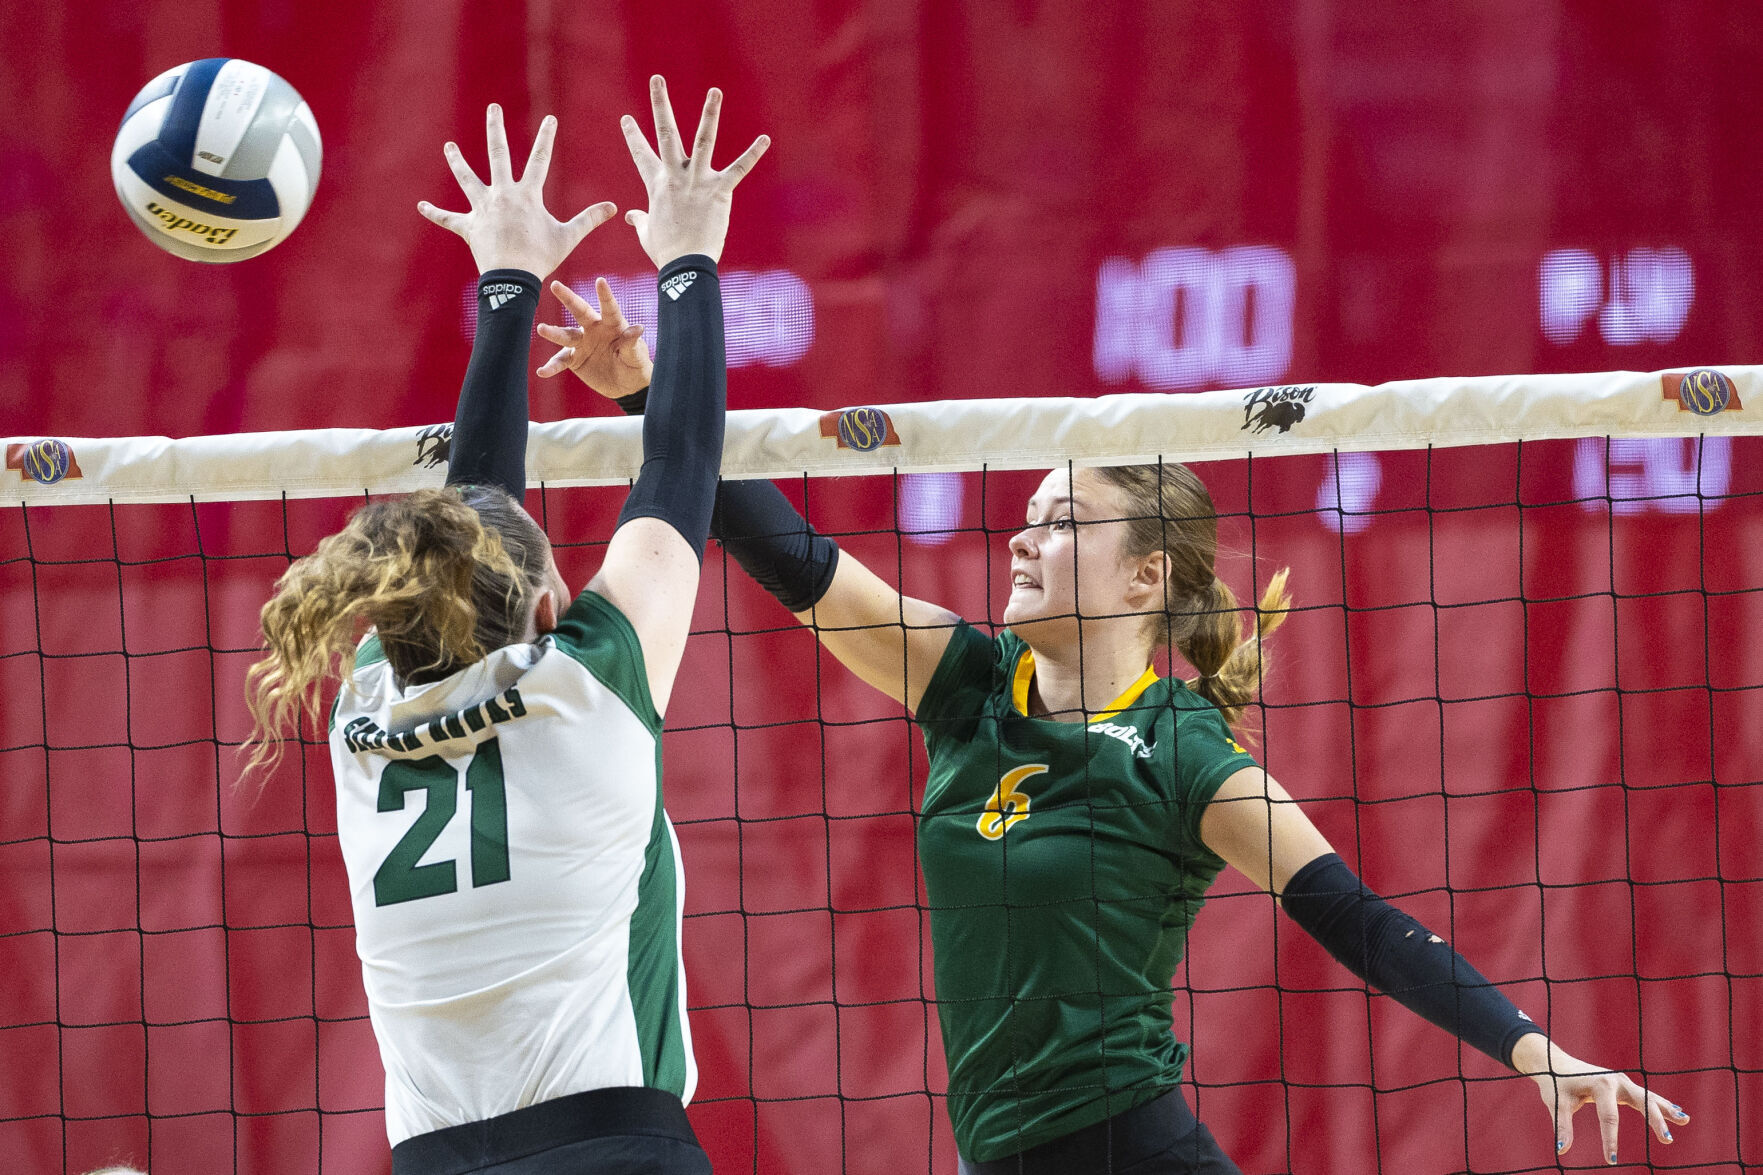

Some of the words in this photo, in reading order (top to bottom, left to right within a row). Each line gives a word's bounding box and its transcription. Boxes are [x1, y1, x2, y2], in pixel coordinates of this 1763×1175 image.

[146, 201, 240, 246] Baden
[482, 283, 523, 296] adidas
[661, 271, 698, 292] adidas
[1243, 386, 1318, 422] Bison
[373, 735, 512, 908] 21
[975, 763, 1050, 842] 6
